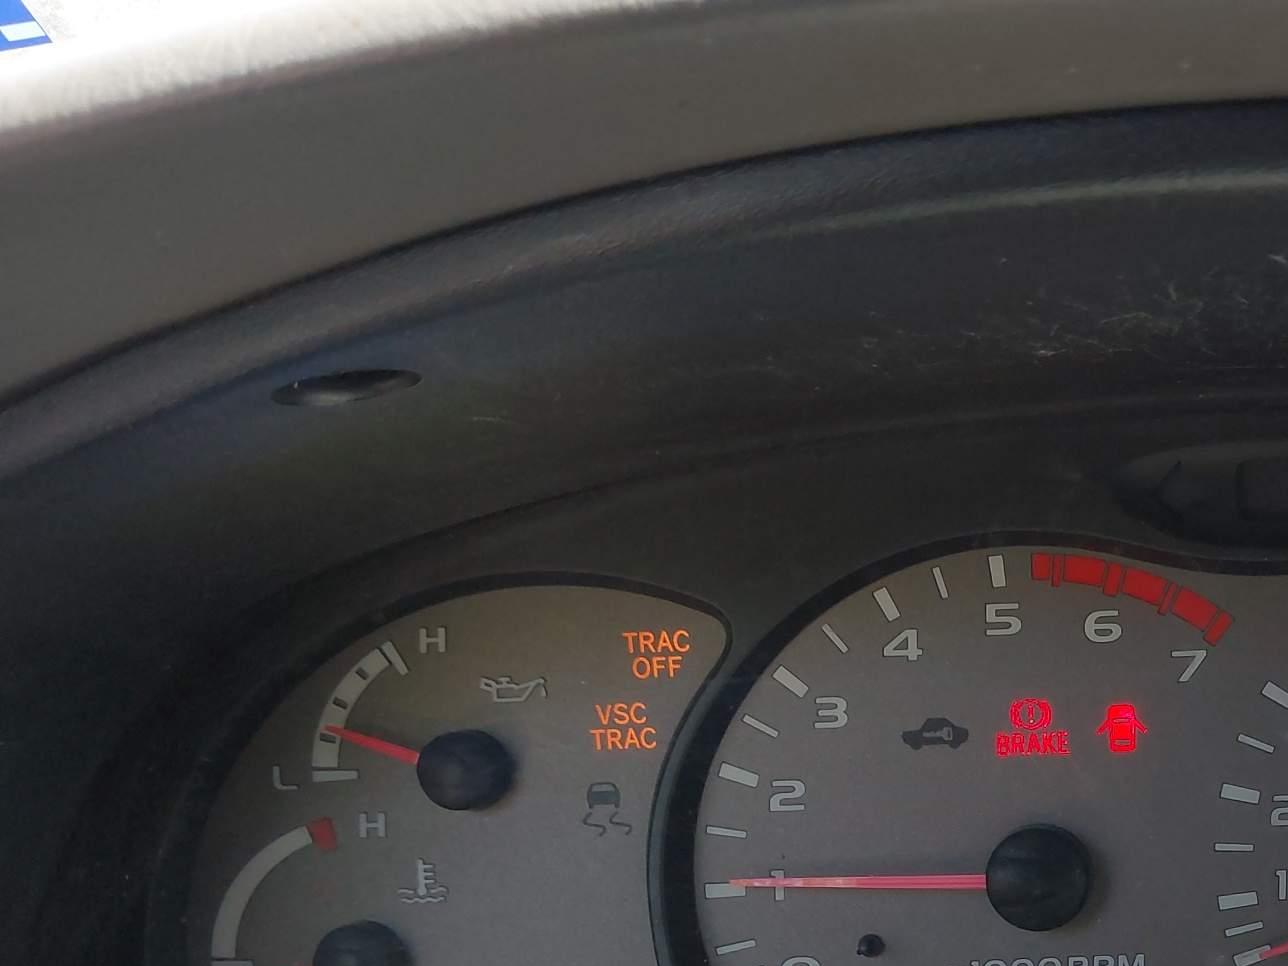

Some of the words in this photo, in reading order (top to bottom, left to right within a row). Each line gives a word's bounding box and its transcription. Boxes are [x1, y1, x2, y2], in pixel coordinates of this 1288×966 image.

[983, 601, 1023, 637] 5
[1083, 608, 1124, 644] 6
[418, 626, 448, 654] H
[622, 629, 692, 655] TRAC
[882, 627, 924, 662] 4
[631, 655, 684, 680] OFF
[1170, 647, 1209, 683] 7
[595, 701, 648, 726] VSC
[812, 694, 850, 730] 3
[590, 726, 658, 751] TRAC
[995, 731, 1072, 758] BRAKE
[272, 764, 299, 792] L
[768, 778, 807, 813] 2
[358, 810, 388, 839] H
[769, 869, 785, 902] 1
